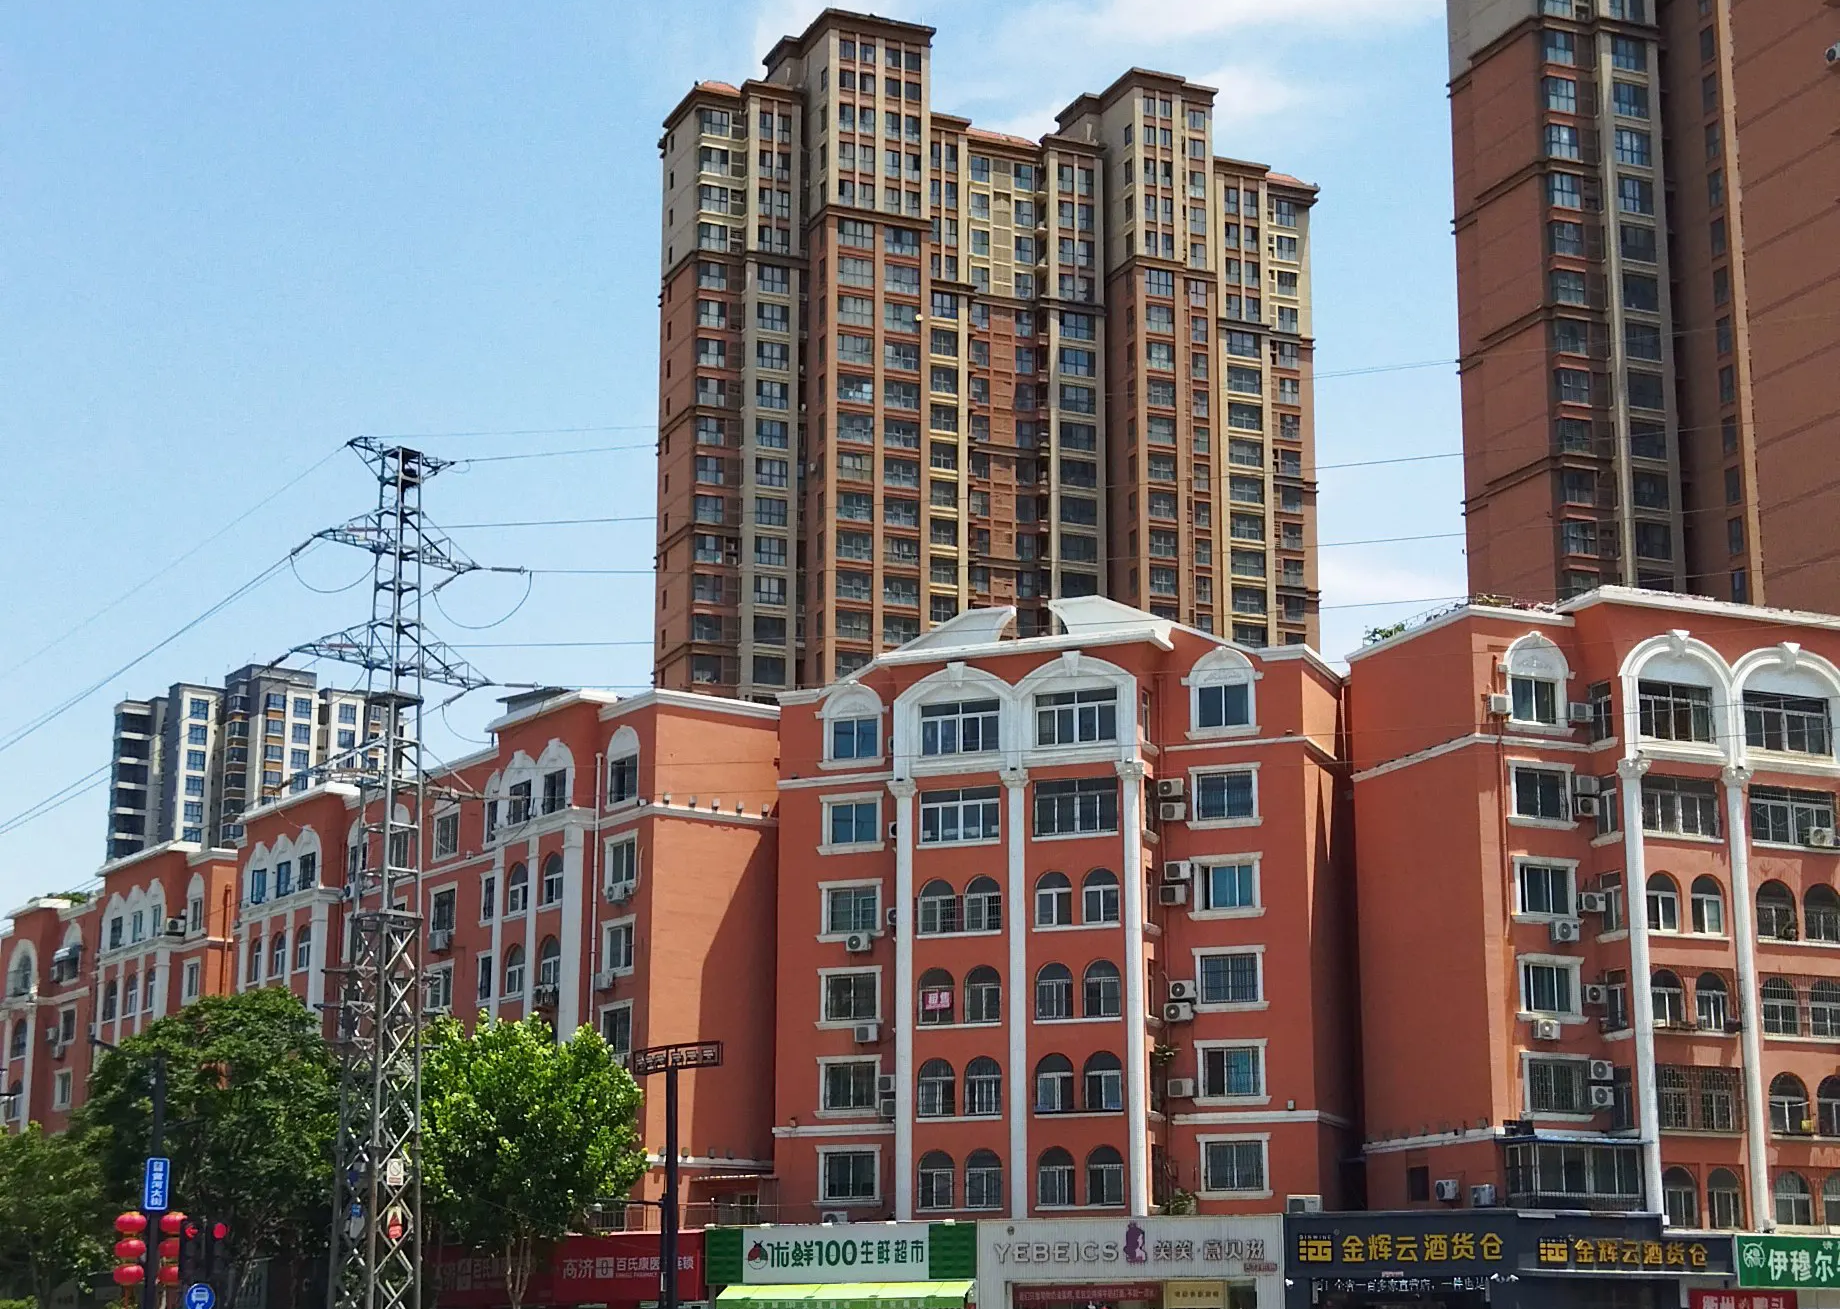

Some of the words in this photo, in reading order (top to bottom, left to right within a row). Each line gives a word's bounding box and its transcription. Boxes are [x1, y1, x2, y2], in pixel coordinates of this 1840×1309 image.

[994, 1241, 1120, 1264] YEBEICS
[1341, 1232, 1504, 1262] 金辉云酒货仓
[1574, 1238, 1708, 1268] 金辉云酒货仓
[1767, 1248, 1840, 1283] 伊穆尔
